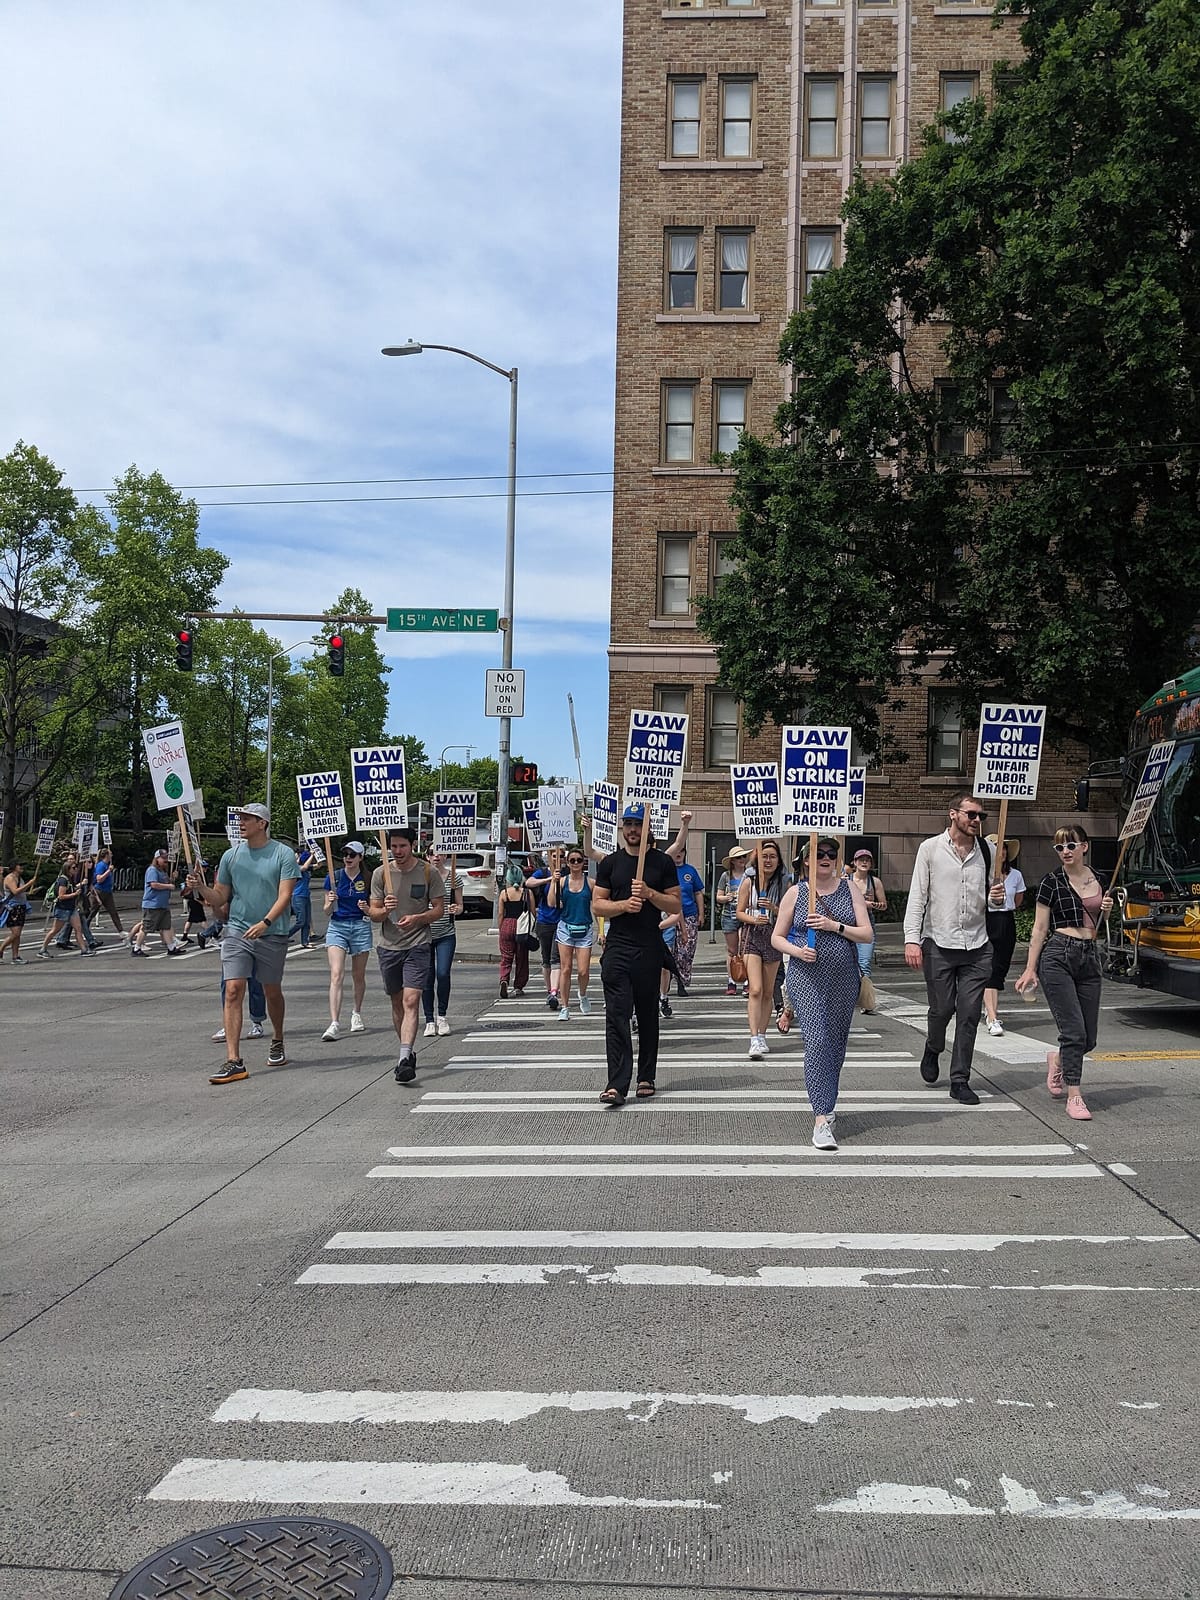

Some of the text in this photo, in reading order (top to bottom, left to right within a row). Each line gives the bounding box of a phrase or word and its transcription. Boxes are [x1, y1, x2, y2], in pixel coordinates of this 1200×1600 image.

[400, 614, 486, 626] 15TH AVE NE
[496, 672, 514, 682] NO
[494, 685, 516, 693] TURN
[496, 706, 514, 714] RED
[984, 708, 1044, 723] UAW
[634, 713, 686, 730] UAW
[648, 733, 668, 747] ON
[786, 730, 848, 746] UAW
[1000, 728, 1022, 742] ON
[158, 742, 170, 754] NO
[982, 742, 1038, 757] STRIKE
[1149, 744, 1174, 762] UAW
[152, 746, 185, 768] CONTRACT
[354, 750, 401, 763] UAW
[631, 747, 682, 763] STRIKE
[804, 751, 828, 766] ON
[636, 764, 674, 778] UNFAIR
[734, 766, 776, 778] UAW
[987, 760, 1030, 772] UNFAIR
[370, 766, 388, 779] ON
[524, 768, 536, 782] 21
[786, 768, 846, 784] STRIKE
[988, 772, 1026, 783] LABOR
[1150, 765, 1160, 780] ON
[300, 773, 338, 786] UAW
[636, 776, 670, 788] LABOR
[357, 780, 402, 792] STRIKE
[595, 782, 618, 798] UAW
[747, 781, 764, 792] ON
[978, 783, 1034, 795] PRACTICE
[1138, 780, 1162, 797] STRIKE
[313, 787, 328, 798] ON
[540, 791, 572, 806] HONK
[626, 787, 678, 800] PRACTICE
[792, 788, 838, 800] UNFAIR
[304, 796, 340, 810] STRIKE
[364, 796, 398, 806] UNFAIR
[436, 794, 475, 804] UAW
[525, 801, 540, 809] UA
[600, 798, 610, 810] ON
[736, 793, 776, 805] STRIKE
[310, 809, 338, 819] UNFAIR
[366, 806, 398, 816] LABOR
[448, 806, 463, 816] ON
[742, 808, 774, 816] UNFAIR
[794, 802, 835, 814] LABOR
[312, 817, 338, 826] LABOR
[360, 816, 406, 826] PRACTICE
[436, 816, 474, 826] STRIKE
[594, 808, 616, 824] STRIKE
[744, 817, 772, 826] LABOR
[784, 814, 845, 828] PRACTICE
[307, 824, 346, 836] PRACTICE
[546, 830, 570, 838] WAGES
[596, 822, 614, 834] UNFAIR
[738, 826, 780, 835] PRACTICE
[596, 830, 612, 842] LABOR
[592, 838, 616, 852] PRACTICE
